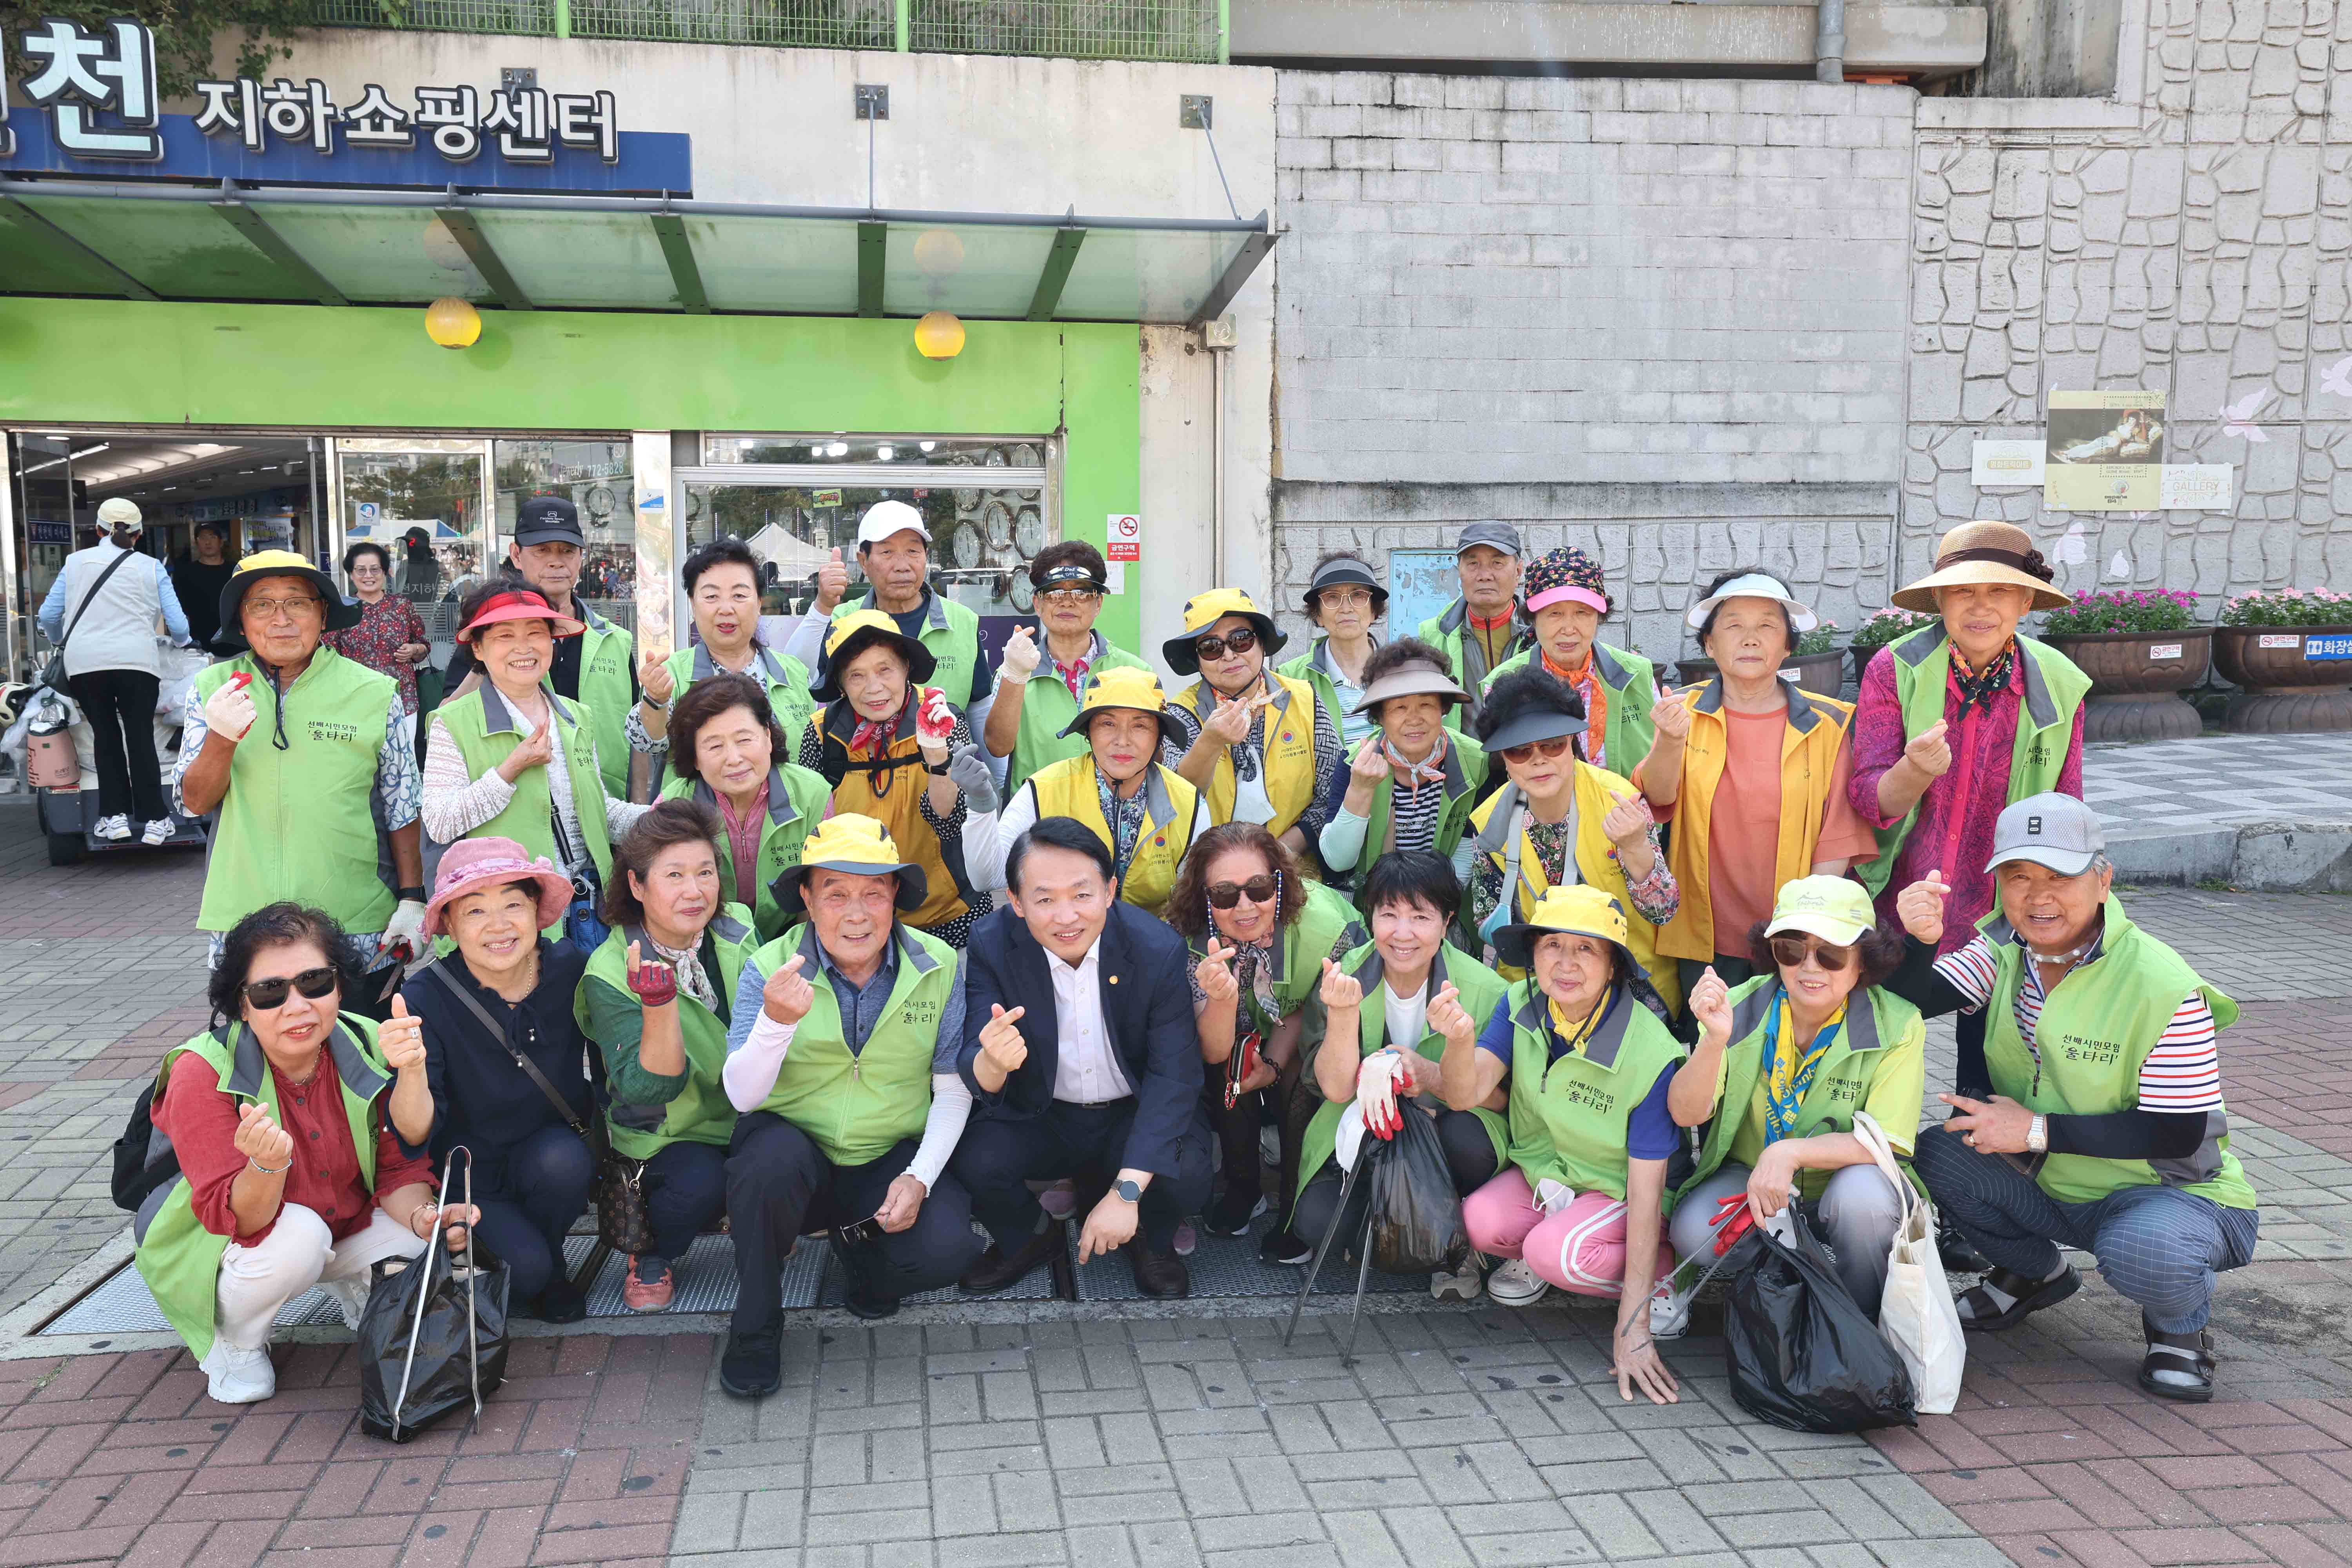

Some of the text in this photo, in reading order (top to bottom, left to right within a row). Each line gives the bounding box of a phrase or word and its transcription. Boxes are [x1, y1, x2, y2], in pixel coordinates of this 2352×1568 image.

[0, 16, 163, 160] 천
[559, 461, 624, 478] Jewerly 772-5828
[2173, 481, 2220, 491] GALLERY
[307, 721, 357, 733] 선배시민모임
[307, 730, 357, 743] '울타리'
[2062, 1034, 2120, 1053] 선배시민모임
[2060, 1045, 2119, 1066] '울타리'
[1566, 1088, 1612, 1115] '울타리'
[1568, 1080, 1614, 1104] 선배시민모임
